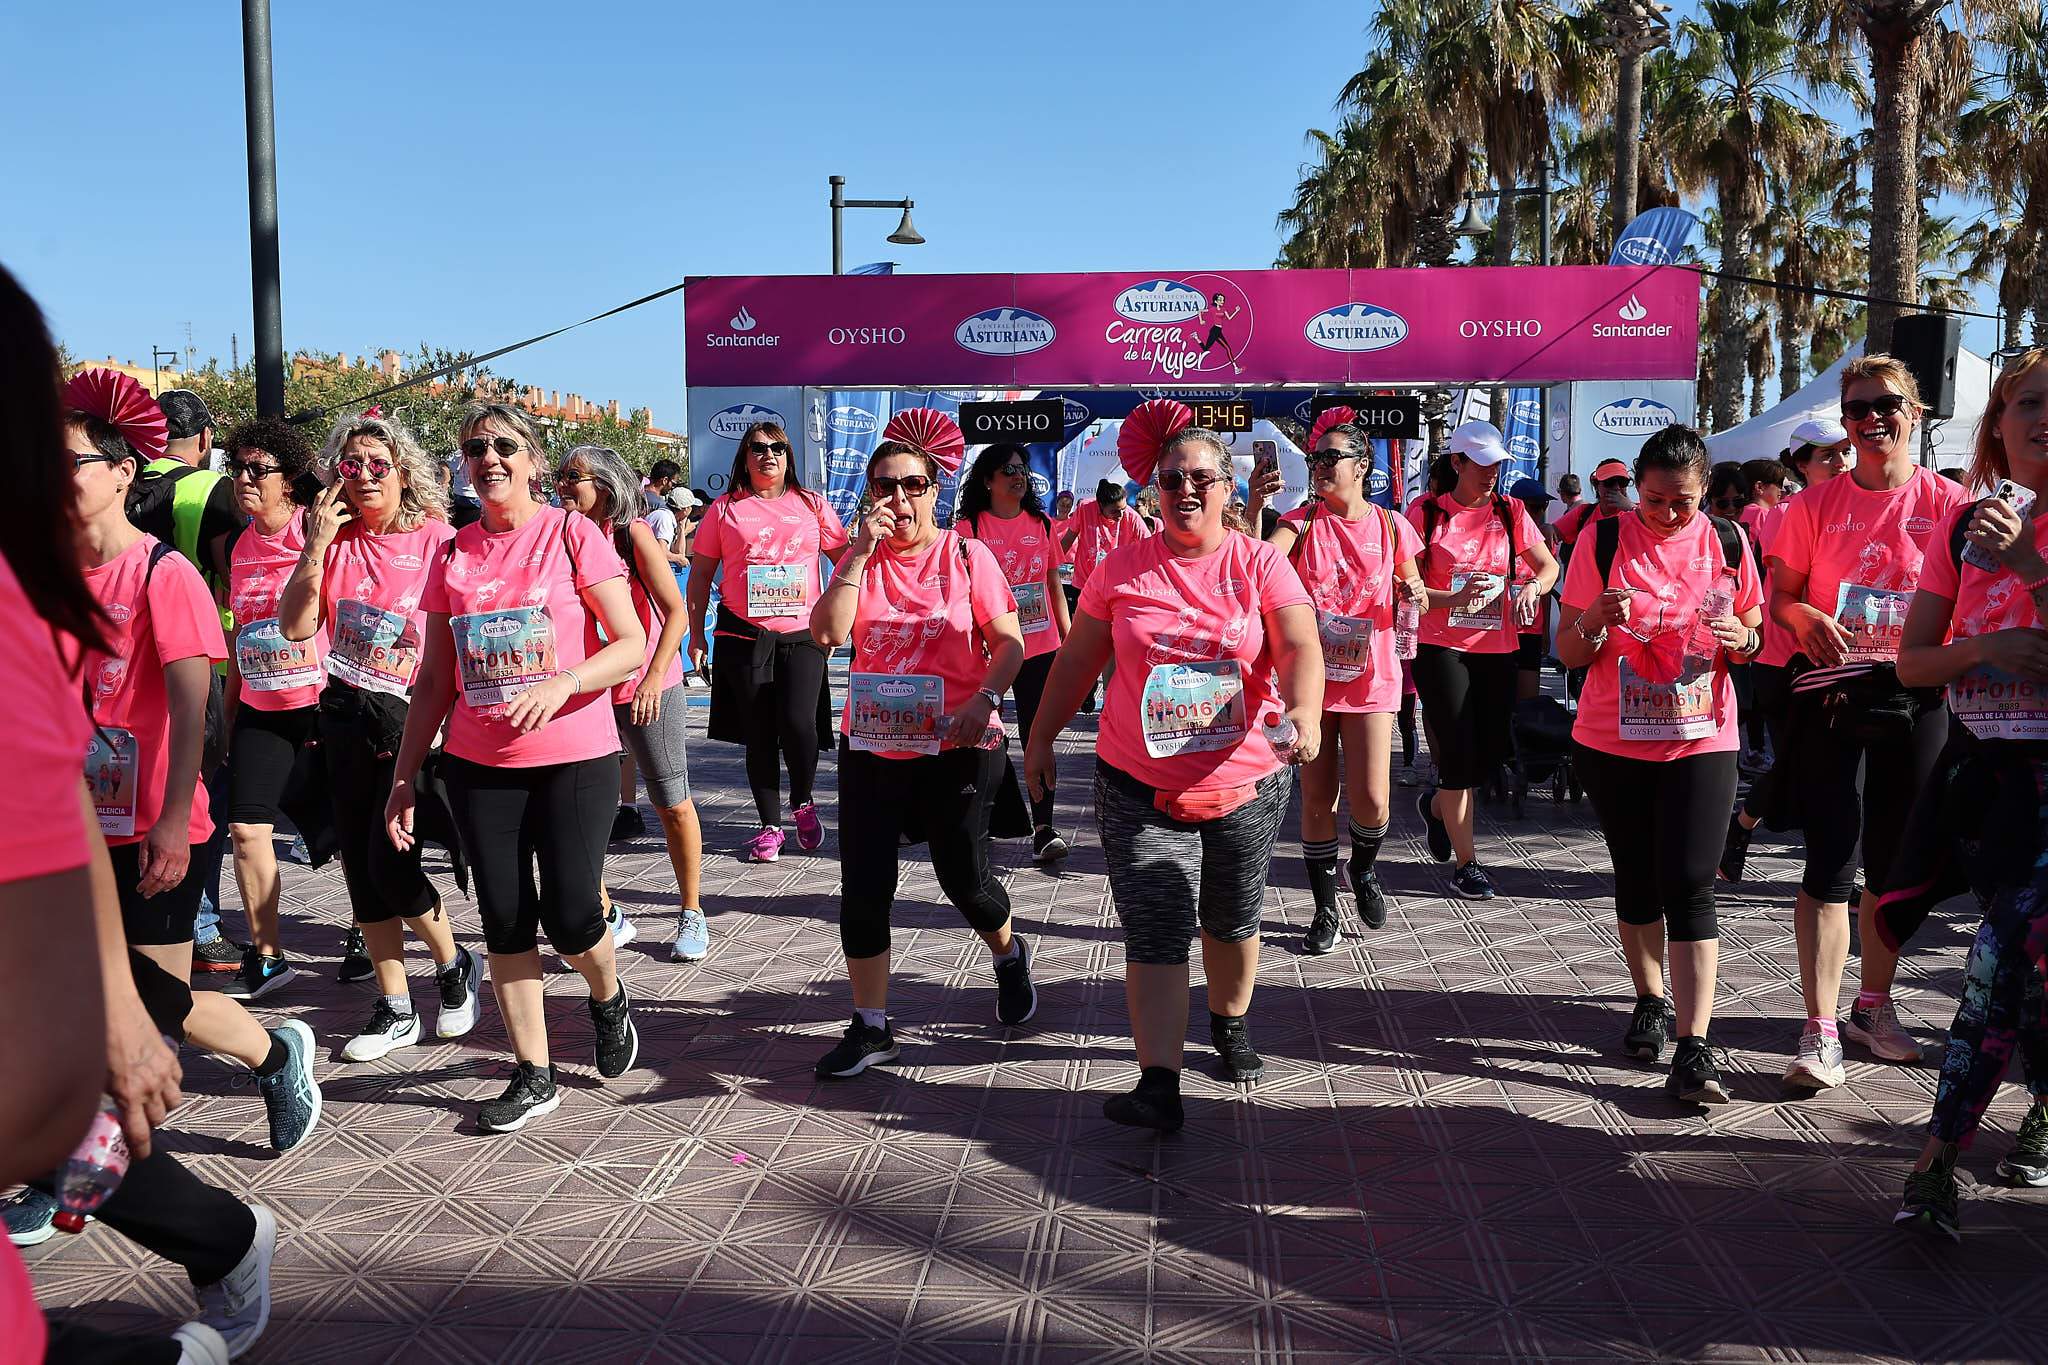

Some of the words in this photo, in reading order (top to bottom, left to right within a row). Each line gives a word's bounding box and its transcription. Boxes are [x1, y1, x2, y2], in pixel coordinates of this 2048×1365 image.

[1121, 295, 1200, 313] ASTURIANA
[828, 327, 906, 345] OYSHO
[962, 324, 1048, 344] ASTURIANA
[1105, 320, 1183, 344] Carrera
[1313, 321, 1400, 340] ASTURIANA
[1459, 319, 1542, 338] OYSHO
[1592, 323, 1672, 337] Santander
[706, 333, 780, 347] Santander
[1124, 344, 1139, 361] de
[1141, 343, 1152, 361] la
[1149, 342, 1211, 378] Mujer
[829, 416, 875, 430] ASTURIANA
[976, 414, 1050, 431] OYSHO
[1194, 405, 1245, 427] 13:46
[1359, 409, 1404, 426] SHO
[1599, 412, 1670, 426] ASTURIANA
[1826, 522, 1866, 534] OYSHO
[767, 587, 790, 597] 016
[482, 624, 520, 635] ASTURIANA
[1865, 624, 1902, 637] 016
[260, 648, 290, 663] 016
[487, 650, 523, 668] 016
[502, 677, 520, 686] MUJER
[525, 673, 552, 683] VALENCIA
[1171, 676, 1209, 686] ASTURIANA
[880, 685, 914, 694] ASTURIANA
[1990, 680, 2034, 699] 016
[1652, 692, 1686, 707] 016
[880, 709, 915, 723] 016
[1175, 701, 1213, 719] 016
[1959, 712, 1984, 720] CARRERA
[1985, 712, 1994, 720] DE
[1150, 733, 1175, 741] CARRERA
[1215, 725, 1240, 734] VALENCIA
[1629, 728, 1661, 736] OYSHO
[1156, 741, 1190, 752] OYSHO
